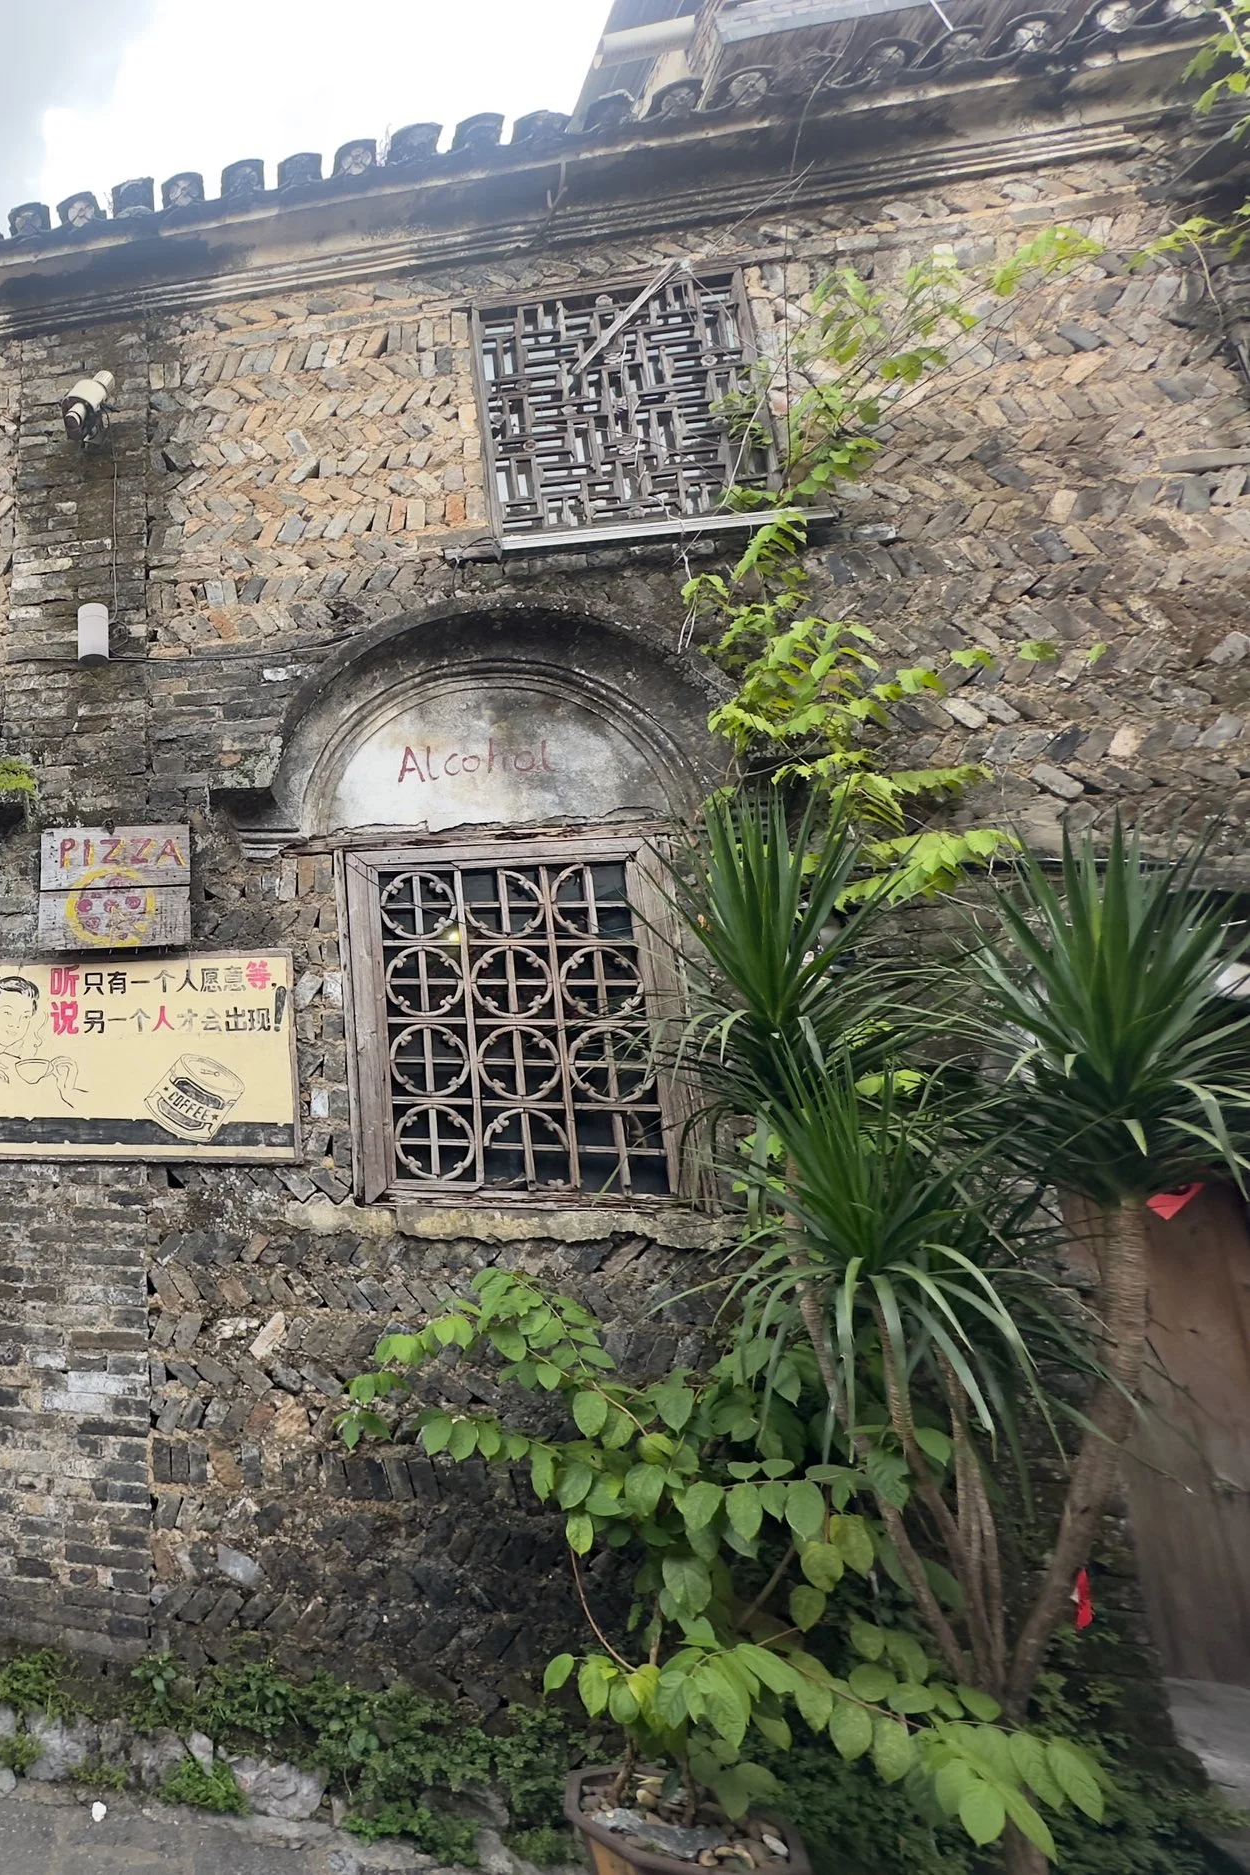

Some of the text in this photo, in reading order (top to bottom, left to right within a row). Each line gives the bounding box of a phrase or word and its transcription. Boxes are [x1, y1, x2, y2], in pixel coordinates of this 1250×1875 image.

[397, 737, 557, 783] Alcohol
[59, 837, 186, 869] PIZZA
[167, 1091, 211, 1121] COFFEE
